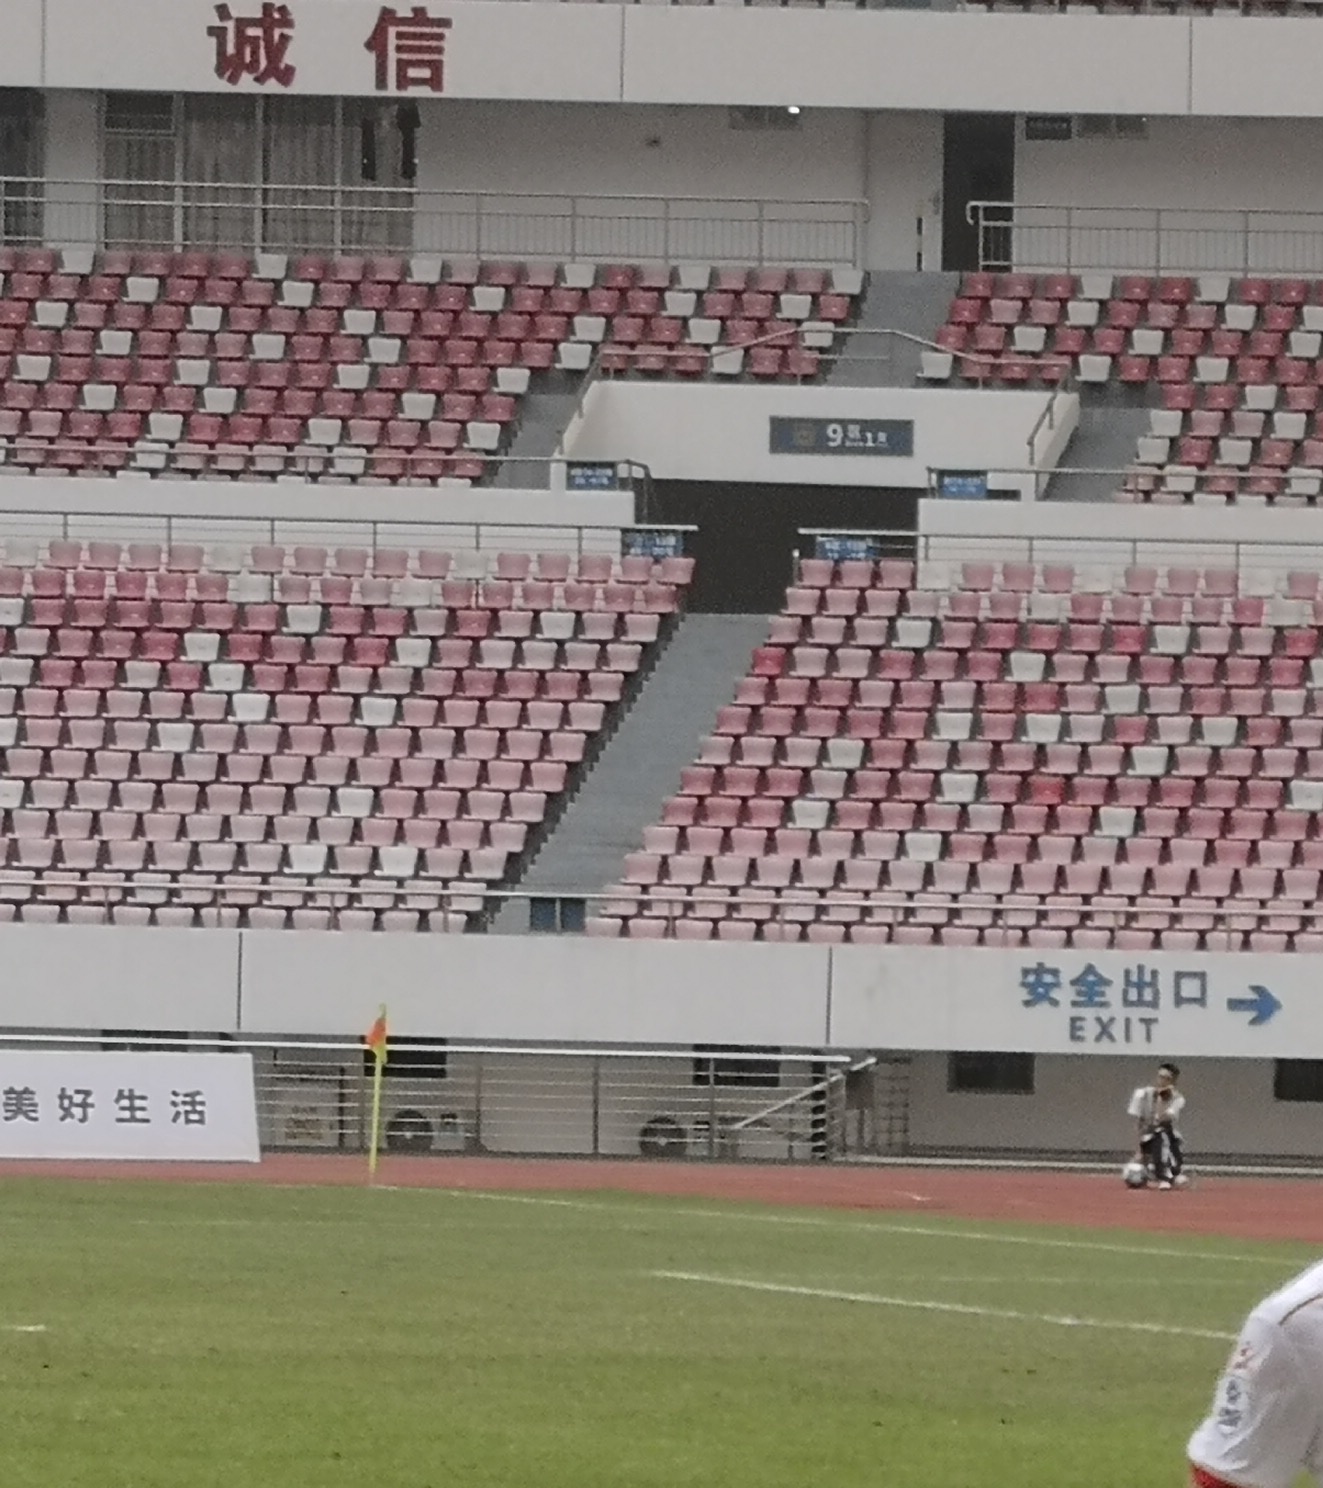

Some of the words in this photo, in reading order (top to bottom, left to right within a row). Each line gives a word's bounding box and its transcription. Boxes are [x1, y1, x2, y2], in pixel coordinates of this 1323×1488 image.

[208, 2, 452, 93] 诚信
[1020, 961, 1209, 1009] 安全出口
[1069, 1016, 1160, 1044] EXIT
[2, 1086, 207, 1126] 美好生活
